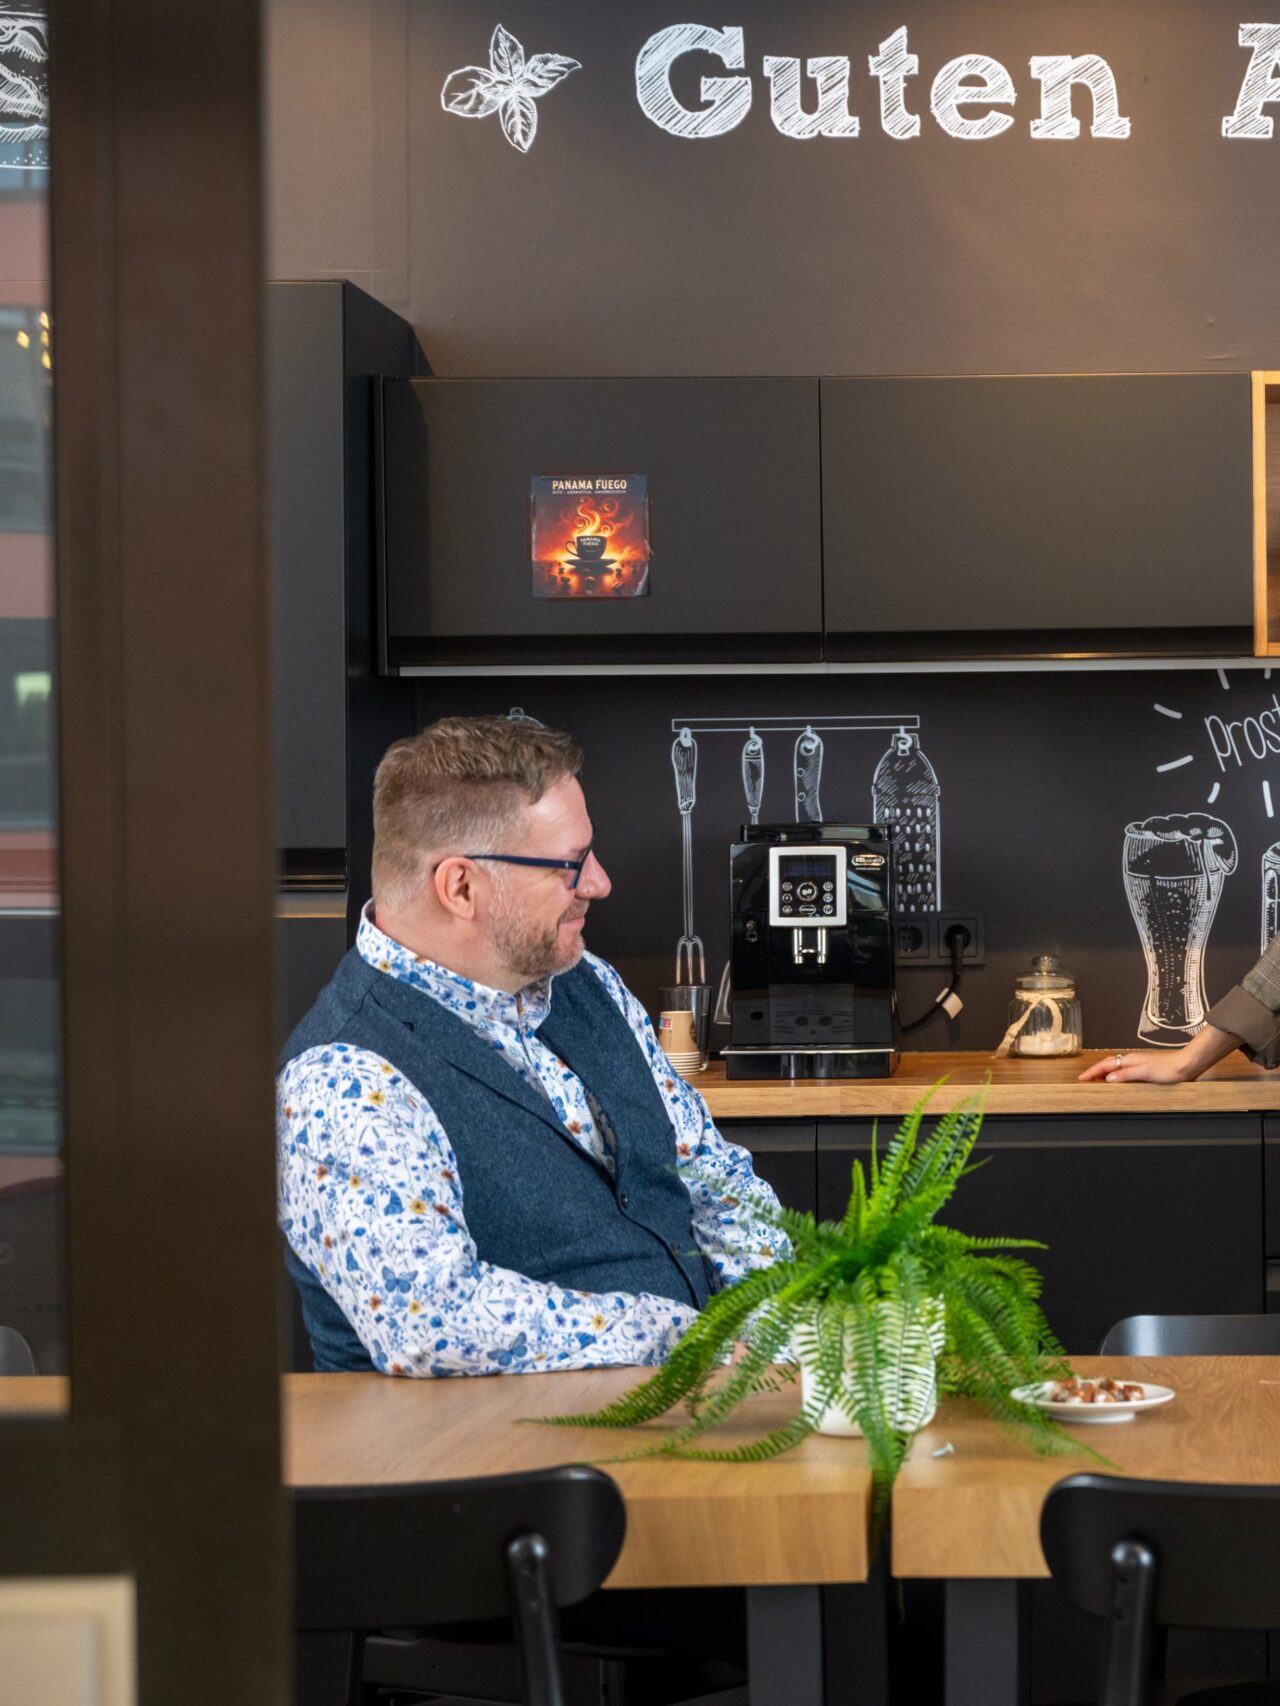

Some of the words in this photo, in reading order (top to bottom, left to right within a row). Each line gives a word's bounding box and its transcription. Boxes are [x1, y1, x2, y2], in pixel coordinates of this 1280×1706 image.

[636, 23, 1131, 139] Guten
[552, 480, 593, 490] PANAMA
[595, 479, 627, 490] FUEGO
